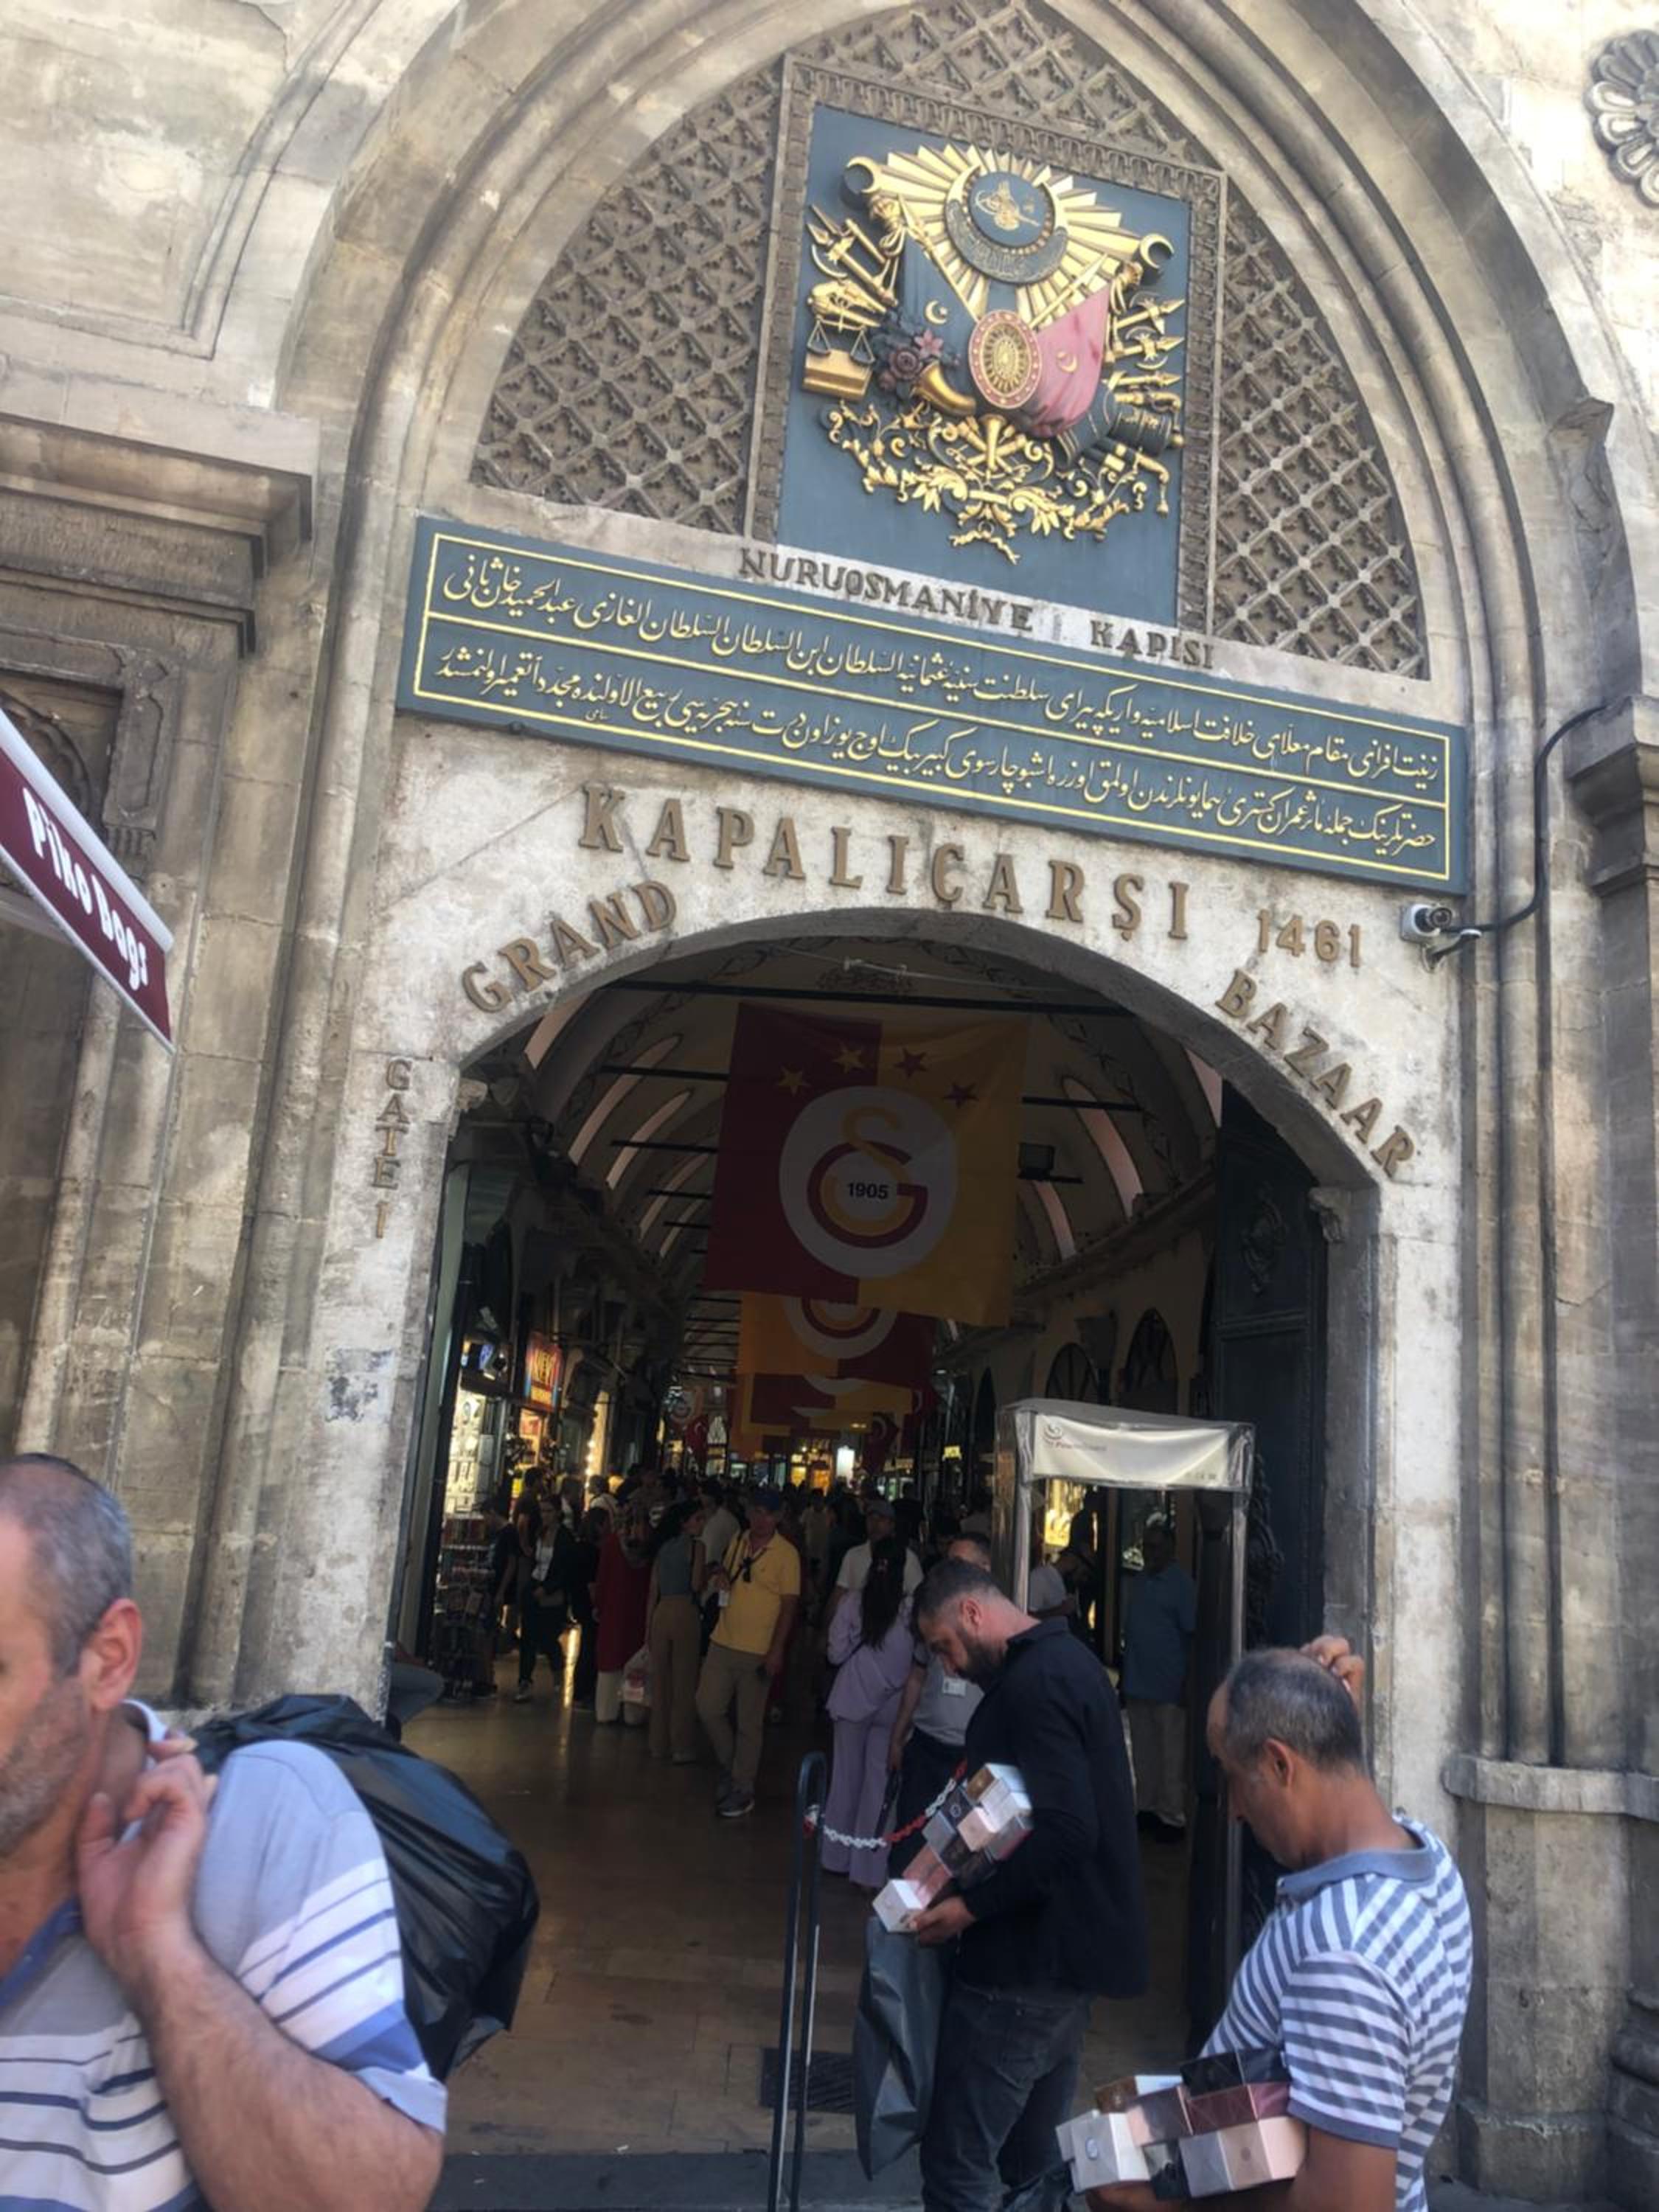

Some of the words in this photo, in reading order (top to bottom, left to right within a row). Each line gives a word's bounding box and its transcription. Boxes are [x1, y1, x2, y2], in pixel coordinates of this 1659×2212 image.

[1090, 620, 1215, 670] KAPISI
[1257, 909, 1363, 968] 1461
[462, 880, 678, 1014] GRAND
[1215, 968, 1415, 1179] BAZAAR
[372, 1059, 412, 1190] GATE
[847, 1180, 888, 1201] 1905
